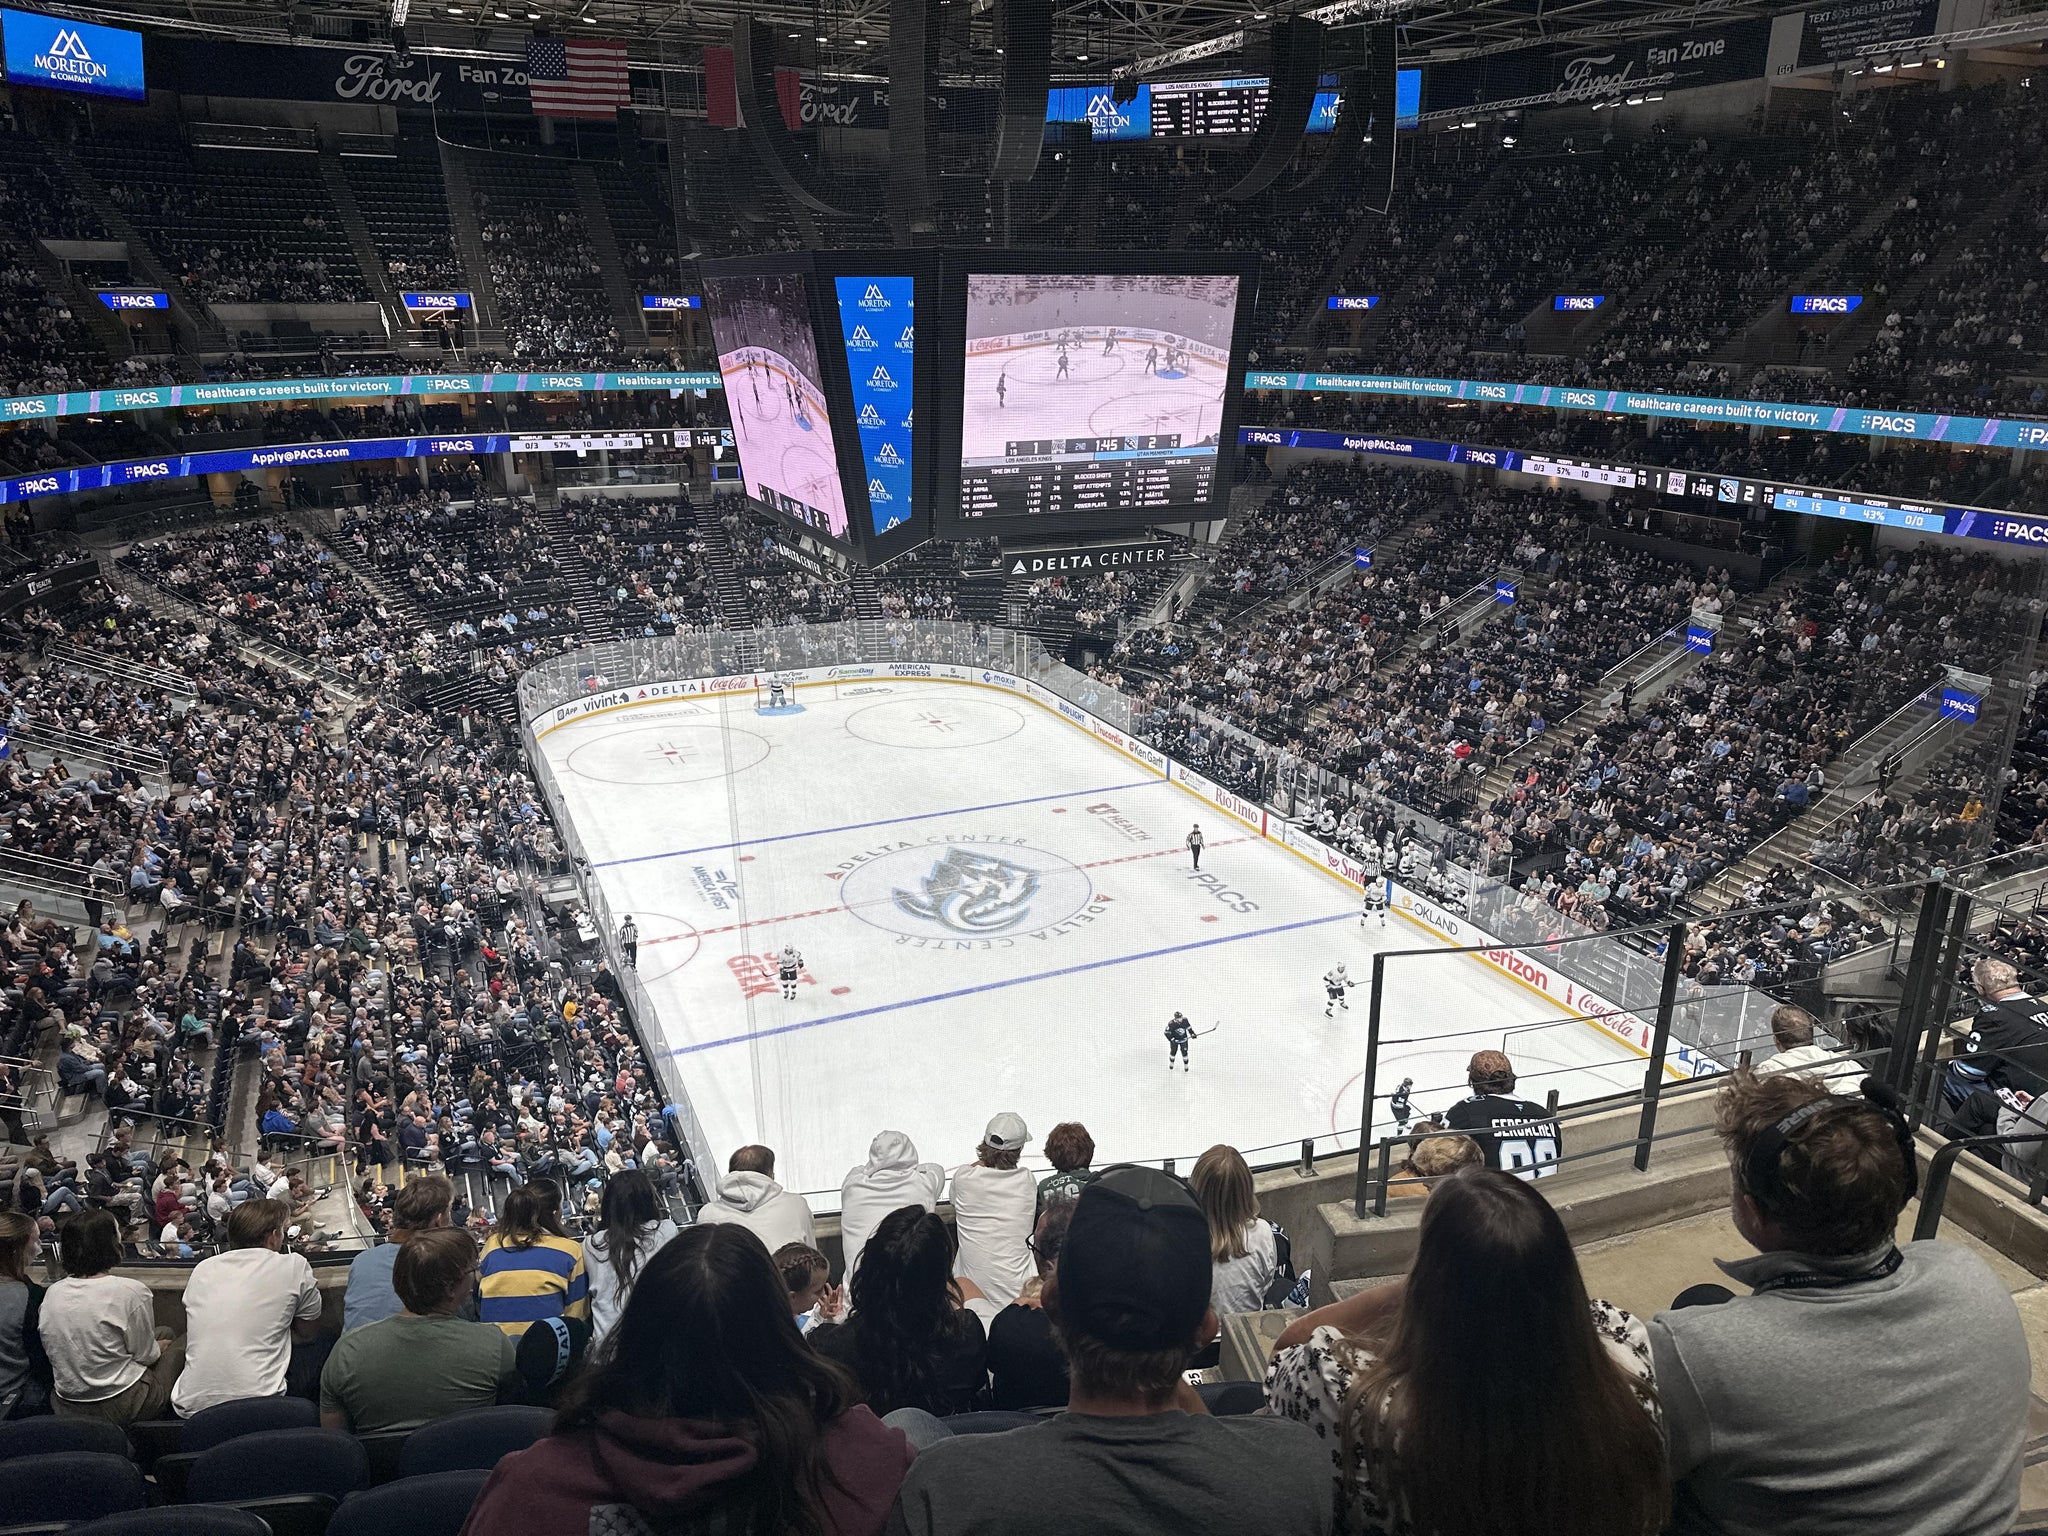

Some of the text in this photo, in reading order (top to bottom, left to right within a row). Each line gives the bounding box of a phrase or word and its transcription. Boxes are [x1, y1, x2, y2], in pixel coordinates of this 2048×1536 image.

[1809, 11, 1831, 24] TEXT
[1851, 3, 1880, 16] DELTA
[1680, 39, 1725, 61] Zone
[34, 54, 107, 77] MORETON
[58, 72, 93, 84] COMPANY
[335, 55, 442, 103] Ford
[458, 65, 498, 84] Fan
[120, 295, 155, 307] PACS
[425, 295, 457, 307] PACS
[662, 298, 690, 307] PACS
[858, 300, 891, 308] MORETON
[1343, 299, 1368, 308] PACS
[1569, 298, 1594, 308] PACS
[1812, 298, 1847, 311] PACS
[846, 340, 878, 348] MORETON
[435, 378, 470, 390] PACS
[549, 377, 583, 388] PACS
[618, 376, 672, 386] Healthcare
[673, 376, 710, 386] careers
[866, 380, 898, 388] MORETON
[1260, 376, 1287, 386] PACS
[1316, 376, 1452, 393] Healthcare careers built for victory.
[196, 381, 392, 400] Healthcare careers built for victory.
[1480, 386, 1506, 398] PACS
[124, 392, 159, 406] PACS
[1566, 392, 1596, 405] PACS
[12, 400, 46, 416] PACS
[1627, 396, 1819, 425] Healthcare careers built for victory.
[1871, 416, 1916, 432] PACS
[662, 434, 668, 445] 1
[696, 436, 716, 445] 1:45
[1148, 437, 1156, 449] 2
[1254, 432, 1281, 444] PACS
[1344, 437, 1412, 452] Apply@PACS.com
[438, 440, 474, 452] PACS
[525, 442, 538, 450] 0/3
[1033, 442, 1038, 454] 1
[1096, 440, 1118, 452] 1:45
[252, 447, 349, 464] Apply@PACS.com
[874, 456, 904, 465] MORETON
[1472, 451, 1496, 464] PACS
[134, 464, 168, 478] PACS
[1534, 464, 1646, 486] 0/3 57% 10 10 38 19
[25, 478, 59, 494] PACS
[1656, 474, 1662, 488] 1
[1692, 482, 1714, 497] 1:45
[1744, 486, 1755, 502] 2
[1764, 493, 1774, 504] 12
[1864, 499, 1888, 508] FACEOFFS
[1786, 498, 1923, 526] 24 15 8 43% 0/0
[1901, 504, 1932, 514] POWER PLAY
[1032, 548, 1165, 572] DELTA CENTER
[1692, 636, 1710, 647] PACS
[838, 668, 874, 677] SameDay
[994, 674, 1016, 686] moxie
[651, 683, 696, 696] DELTA
[583, 692, 618, 712] vivint
[1949, 700, 1975, 714] PACS
[564, 706, 578, 718] App
[1059, 702, 1085, 722] BUD LIGHT
[1095, 722, 1123, 747] Trucordia
[1134, 744, 1164, 768] Ken Garff
[1108, 813, 1152, 841] HEALTH
[837, 834, 1027, 870] DELTA CENTER
[692, 866, 717, 895] AMERICA
[710, 891, 730, 910] FIRST
[1188, 873, 1260, 914] PACS
[1414, 902, 1458, 936] OKLAND
[895, 904, 1106, 950] DELTA CENTER
[1478, 938, 1548, 990] verizon
[726, 954, 780, 1000] GEEK
